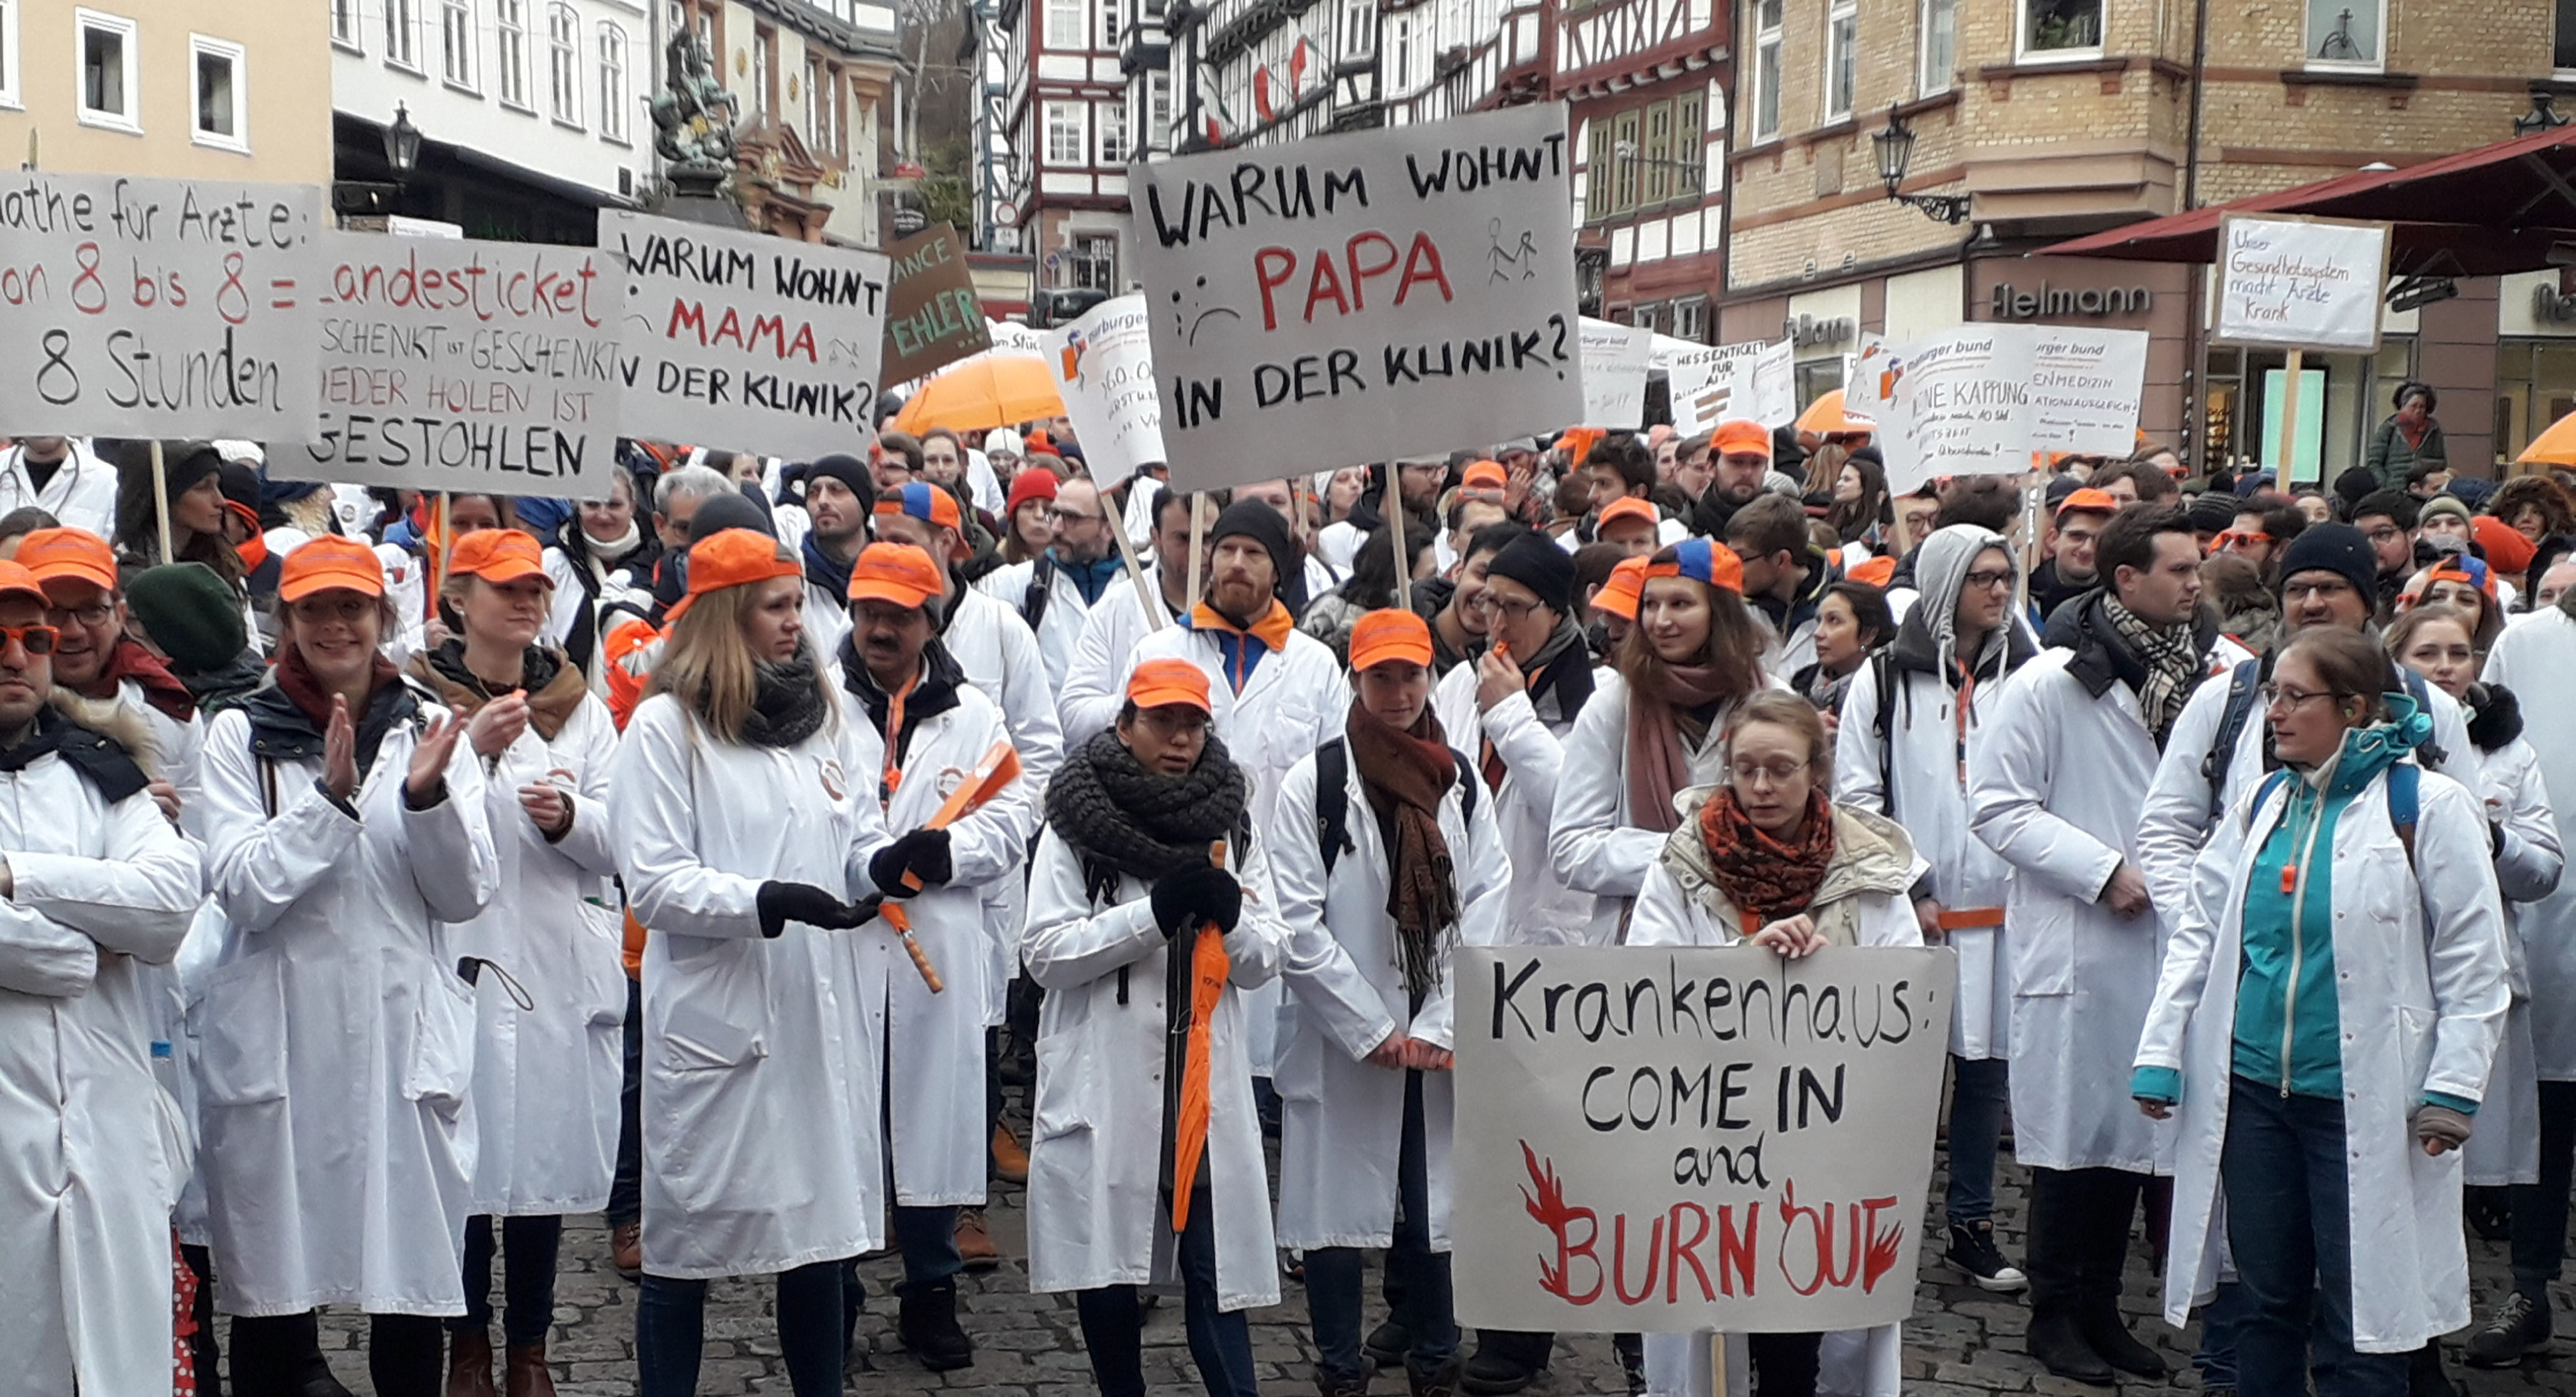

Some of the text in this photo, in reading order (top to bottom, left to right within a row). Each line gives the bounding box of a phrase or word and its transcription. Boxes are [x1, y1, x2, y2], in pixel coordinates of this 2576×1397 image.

[1146, 131, 1566, 248] WARUM WOHNT
[72, 242, 107, 314] 8
[132, 255, 187, 308] bis
[216, 252, 250, 325] 8
[319, 247, 602, 328] andesticket
[620, 233, 882, 316] WARUM WOHNT
[1254, 230, 1454, 331] PAPA
[470, 328, 620, 381] GESCHENKT
[665, 297, 818, 364] MAMA
[1677, 342, 1764, 366] HESSENTICKET
[1955, 338, 1993, 353] bund
[2070, 342, 2106, 355] bund
[36, 325, 283, 413] 8 Stunden
[428, 375, 531, 413] HOLEN
[553, 389, 594, 423] IST
[657, 360, 730, 405] DER
[743, 370, 873, 434] KLINIK?
[1174, 377, 1222, 430] IN
[1253, 348, 1366, 409] DER
[1384, 314, 1569, 387] KLINIK?
[1953, 379, 2029, 406] KAPPUNG
[1491, 954, 1935, 1048] Krankenhaus:
[1581, 1062, 1845, 1133] COME IN
[1674, 1130, 1771, 1189] and
[1541, 1186, 1902, 1306] BURN OUT
